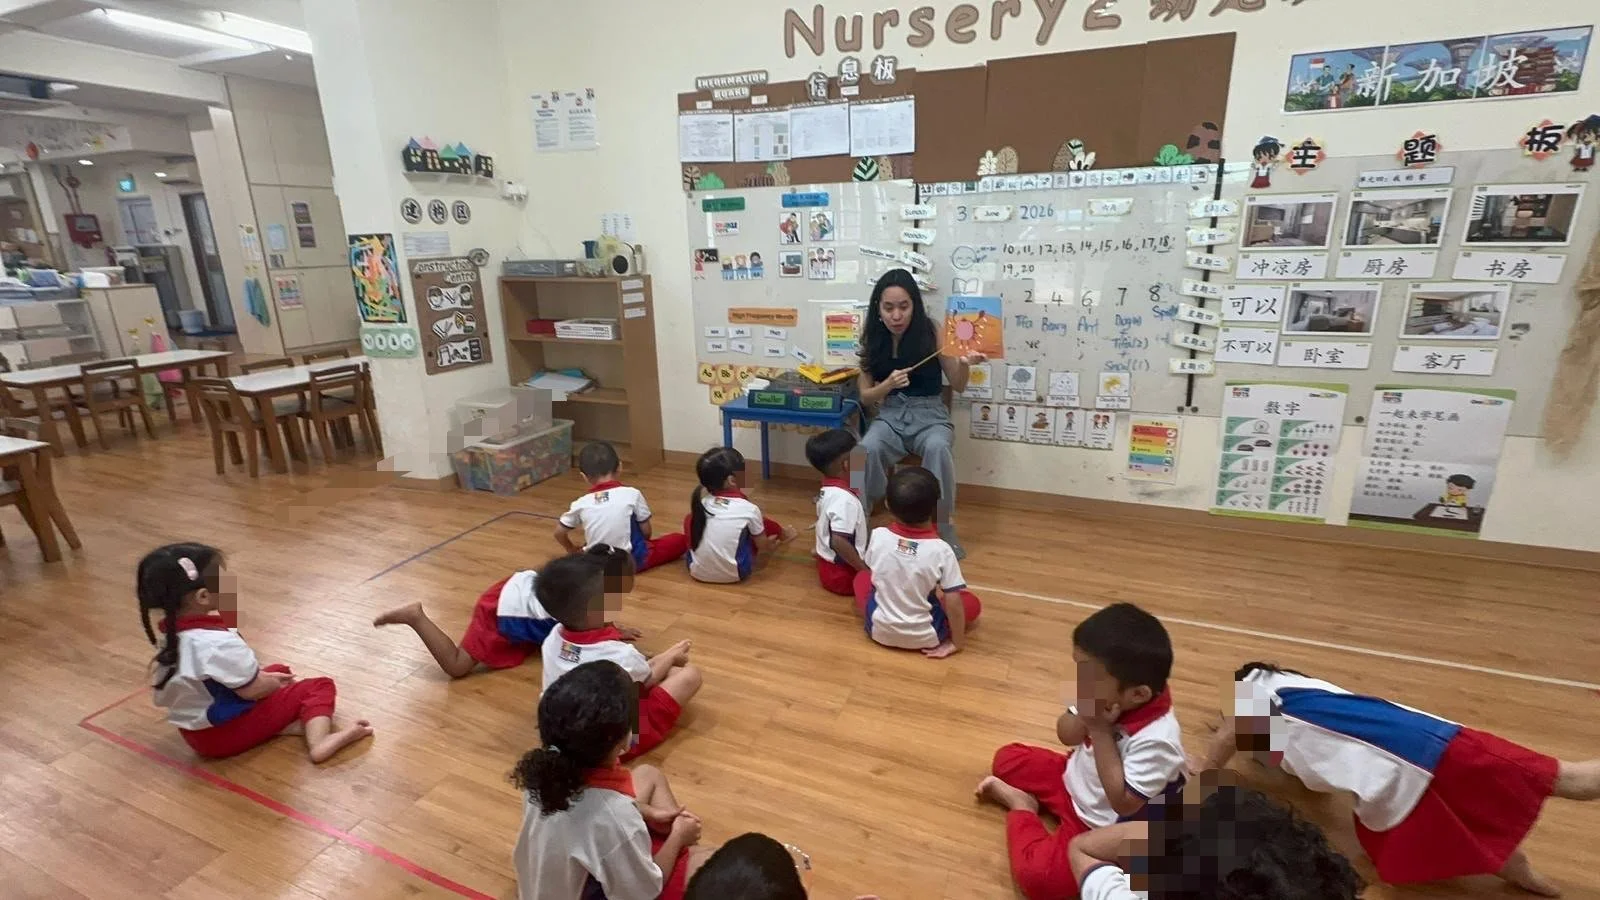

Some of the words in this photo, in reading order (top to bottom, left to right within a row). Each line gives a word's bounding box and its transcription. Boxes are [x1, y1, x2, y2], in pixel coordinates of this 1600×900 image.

[784, 0, 1066, 58] Nursery
[697, 72, 767, 88] INFORMATION
[808, 57, 896, 97] 信息板
[1356, 47, 1529, 101] 新加坡
[714, 87, 748, 98] BOARD
[957, 205, 967, 221] 3
[1019, 205, 1054, 220] 2026
[1251, 258, 1313, 276] 冲凉房
[1362, 257, 1408, 276] 厨房
[1485, 259, 1532, 279] 书房
[1024, 290, 1033, 303] 2
[1051, 291, 1063, 306] 4
[1081, 290, 1093, 307] 6
[1117, 287, 1127, 306] 7
[1149, 285, 1161, 302] 8
[1191, 284, 1217, 294] 星期三
[1188, 310, 1213, 320] 星期四
[1229, 296, 1277, 316] 可以
[1222, 340, 1272, 354] 不可以
[1304, 347, 1344, 364] 卧室
[1422, 352, 1466, 370] 客厅
[1264, 401, 1301, 416] 数字
